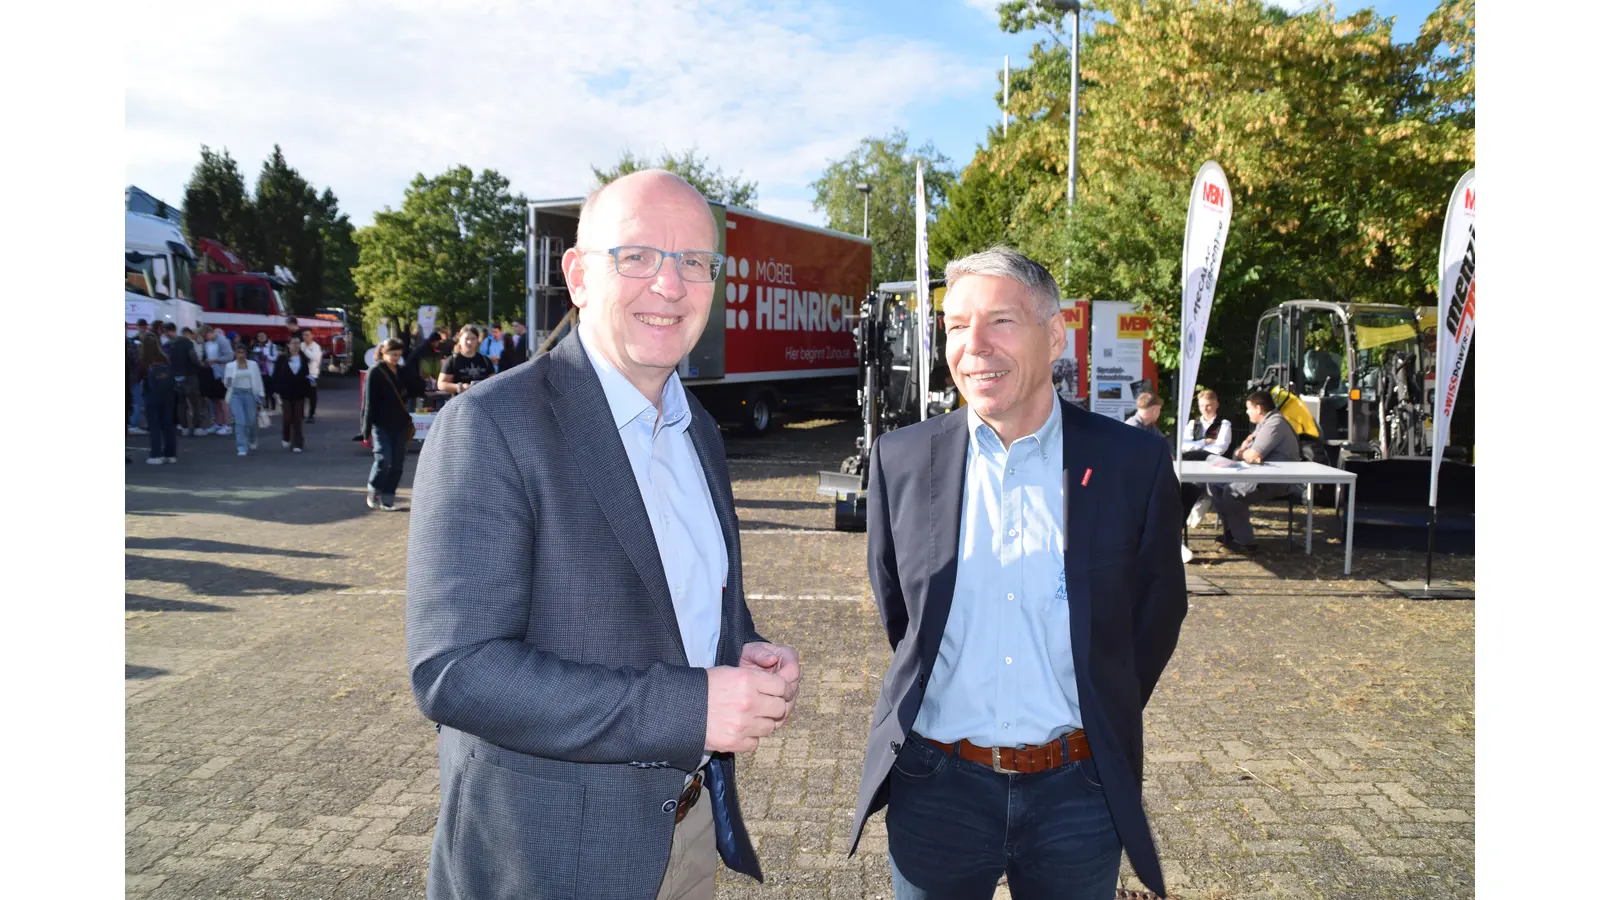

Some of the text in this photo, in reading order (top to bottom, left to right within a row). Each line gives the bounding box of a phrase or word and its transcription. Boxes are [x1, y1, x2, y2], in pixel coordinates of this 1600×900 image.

[1202, 181, 1225, 207] MBN
[756, 257, 796, 285] MÖBEL
[755, 285, 855, 333] HEINRICH
